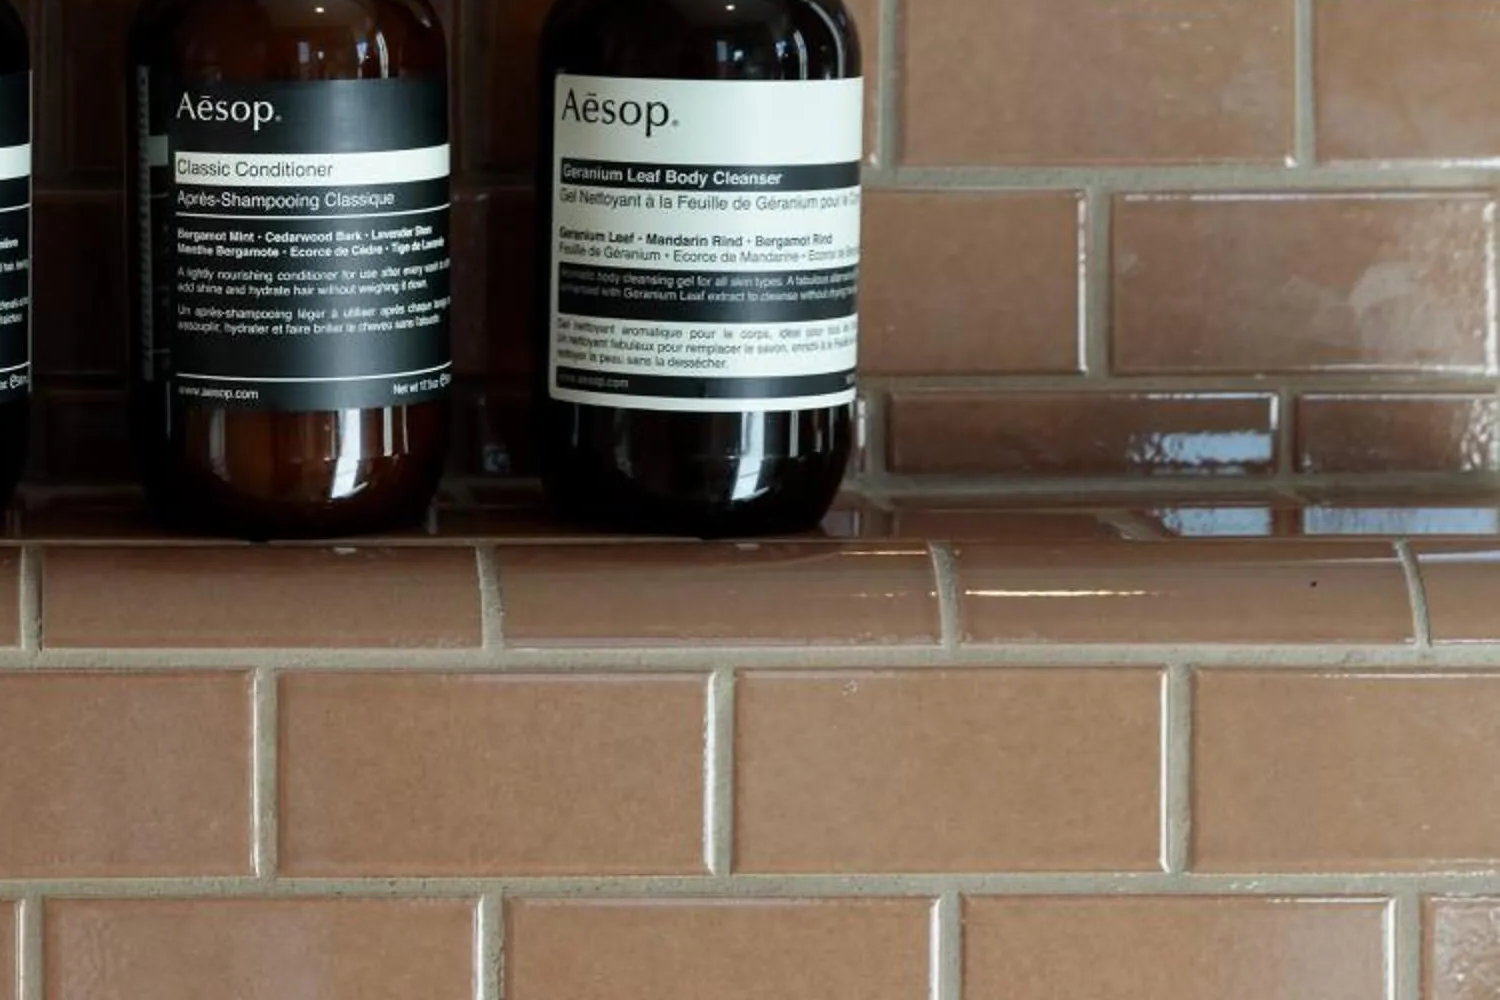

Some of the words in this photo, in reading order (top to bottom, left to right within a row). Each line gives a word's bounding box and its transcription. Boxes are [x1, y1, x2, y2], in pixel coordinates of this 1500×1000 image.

[176, 92, 282, 132] Aēsop.
[560, 87, 680, 138] Aēsop.
[177, 158, 231, 177] Classic
[235, 161, 333, 178] Conditioner
[562, 162, 623, 182] Geranium
[627, 168, 661, 183] Leaf
[665, 169, 708, 188] Body
[712, 170, 783, 186] Cleanser
[177, 189, 320, 210] Après-Shampooing
[324, 190, 396, 208] Classique
[658, 194, 673, 208] la
[677, 194, 728, 210] Feuille
[732, 195, 751, 210] de
[177, 227, 227, 242] Bergamot
[229, 231, 255, 242] Mint
[264, 231, 333, 243] Cedarwood
[335, 231, 363, 242] Bark
[608, 231, 635, 244] Leaf
[645, 232, 709, 247] Mandarin
[712, 235, 743, 247] Rind
[755, 235, 811, 251] Bergamot
[290, 246, 333, 257] Ecorce
[603, 245, 662, 262] Géranium
[673, 249, 718, 263] Ecorce
[719, 251, 738, 263] de
[217, 270, 273, 284] nourishing
[293, 284, 315, 296] hair
